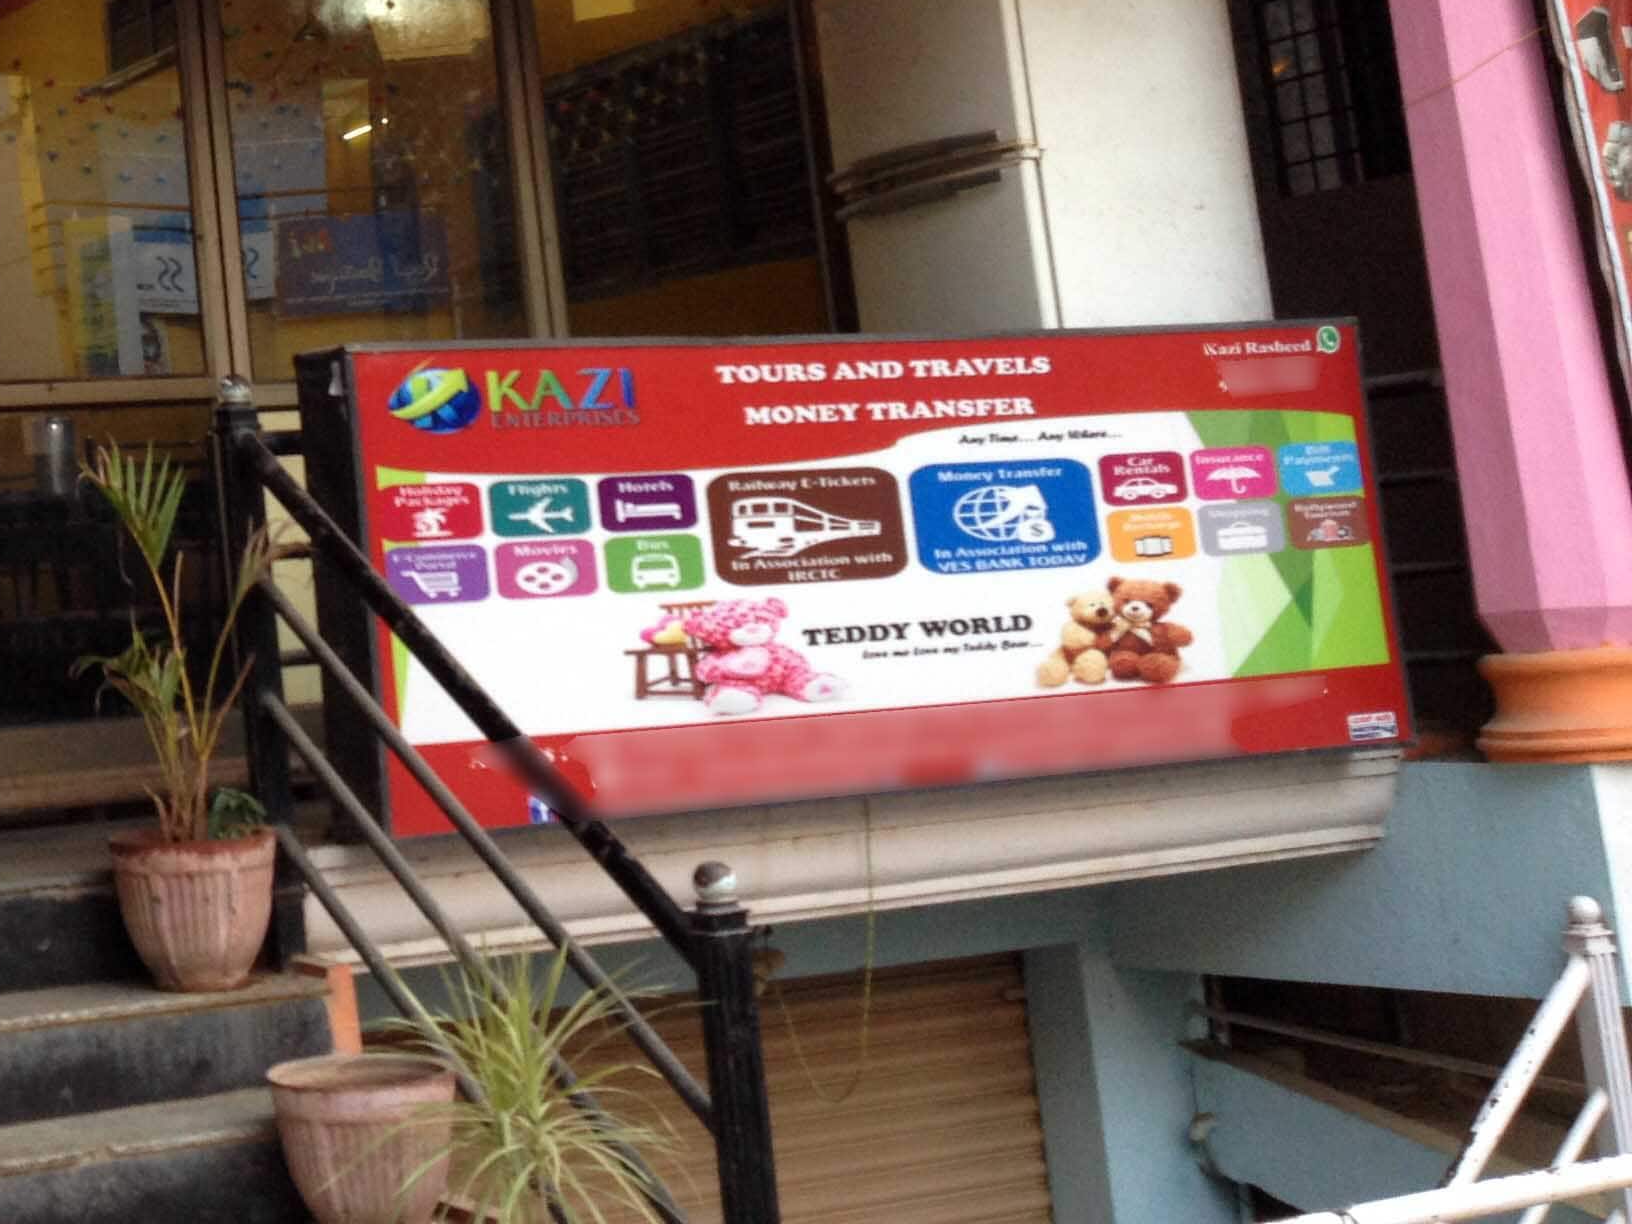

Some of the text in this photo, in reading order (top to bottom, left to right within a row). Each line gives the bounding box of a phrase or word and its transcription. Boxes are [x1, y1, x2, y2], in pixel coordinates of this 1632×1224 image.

[1245, 340, 1311, 354] Rasheed
[715, 356, 1052, 384] TOURS AND TRAVELS
[485, 367, 636, 412] KAZI
[491, 408, 641, 429] ENTERPRISES
[743, 397, 1036, 426] MONEY TRANSFER
[958, 434, 985, 446] Any
[1038, 431, 1064, 443] Any
[1127, 457, 1154, 467] Car
[1195, 453, 1264, 465] Insurance
[937, 465, 1063, 484] Money Transfer
[1113, 465, 1172, 476] Rentals
[507, 484, 569, 497] Flights
[618, 481, 674, 493] Hotels
[727, 480, 797, 492] Railway
[514, 544, 578, 556] Movies
[637, 539, 669, 551] Bus
[933, 541, 1088, 559] In Association with
[731, 552, 893, 571] In Association with
[975, 557, 1024, 570] BANK
[802, 614, 1033, 646] TEDDY WORLD
